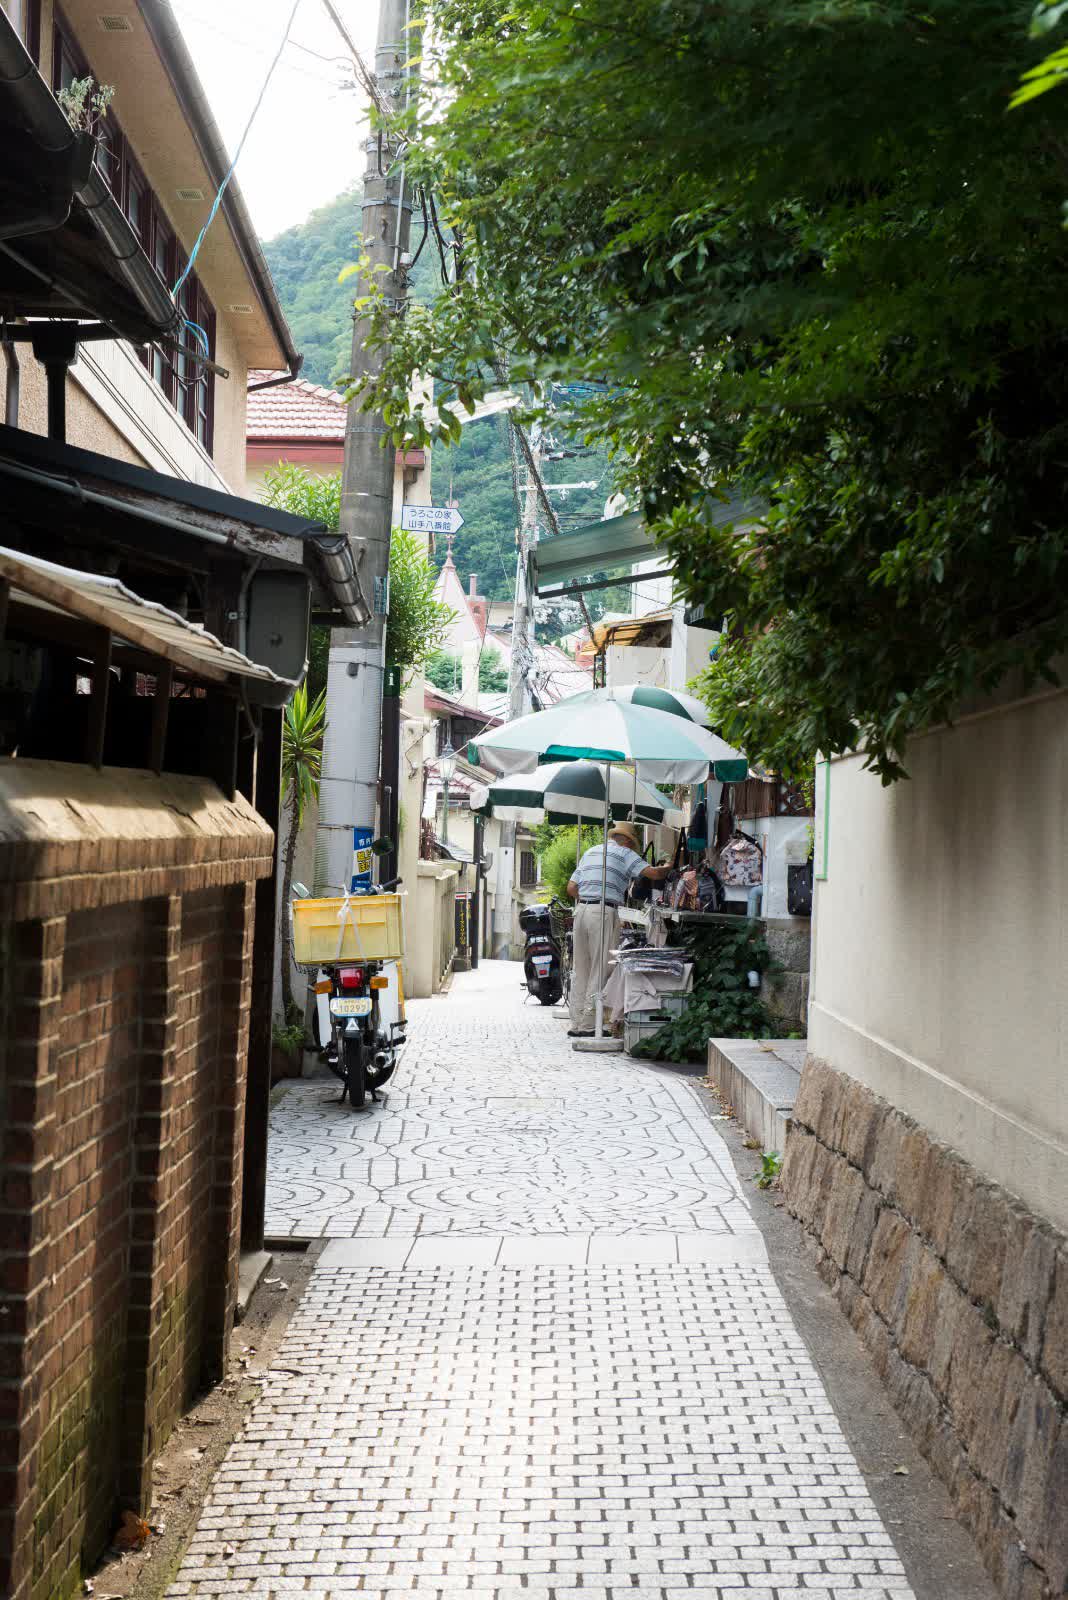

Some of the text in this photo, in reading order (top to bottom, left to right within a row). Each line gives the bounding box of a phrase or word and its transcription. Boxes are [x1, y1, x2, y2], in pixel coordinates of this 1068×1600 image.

[409, 509, 452, 519] うろこの家
[408, 520, 451, 530] 山手八番館
[340, 1004, 367, 1013] 10292
